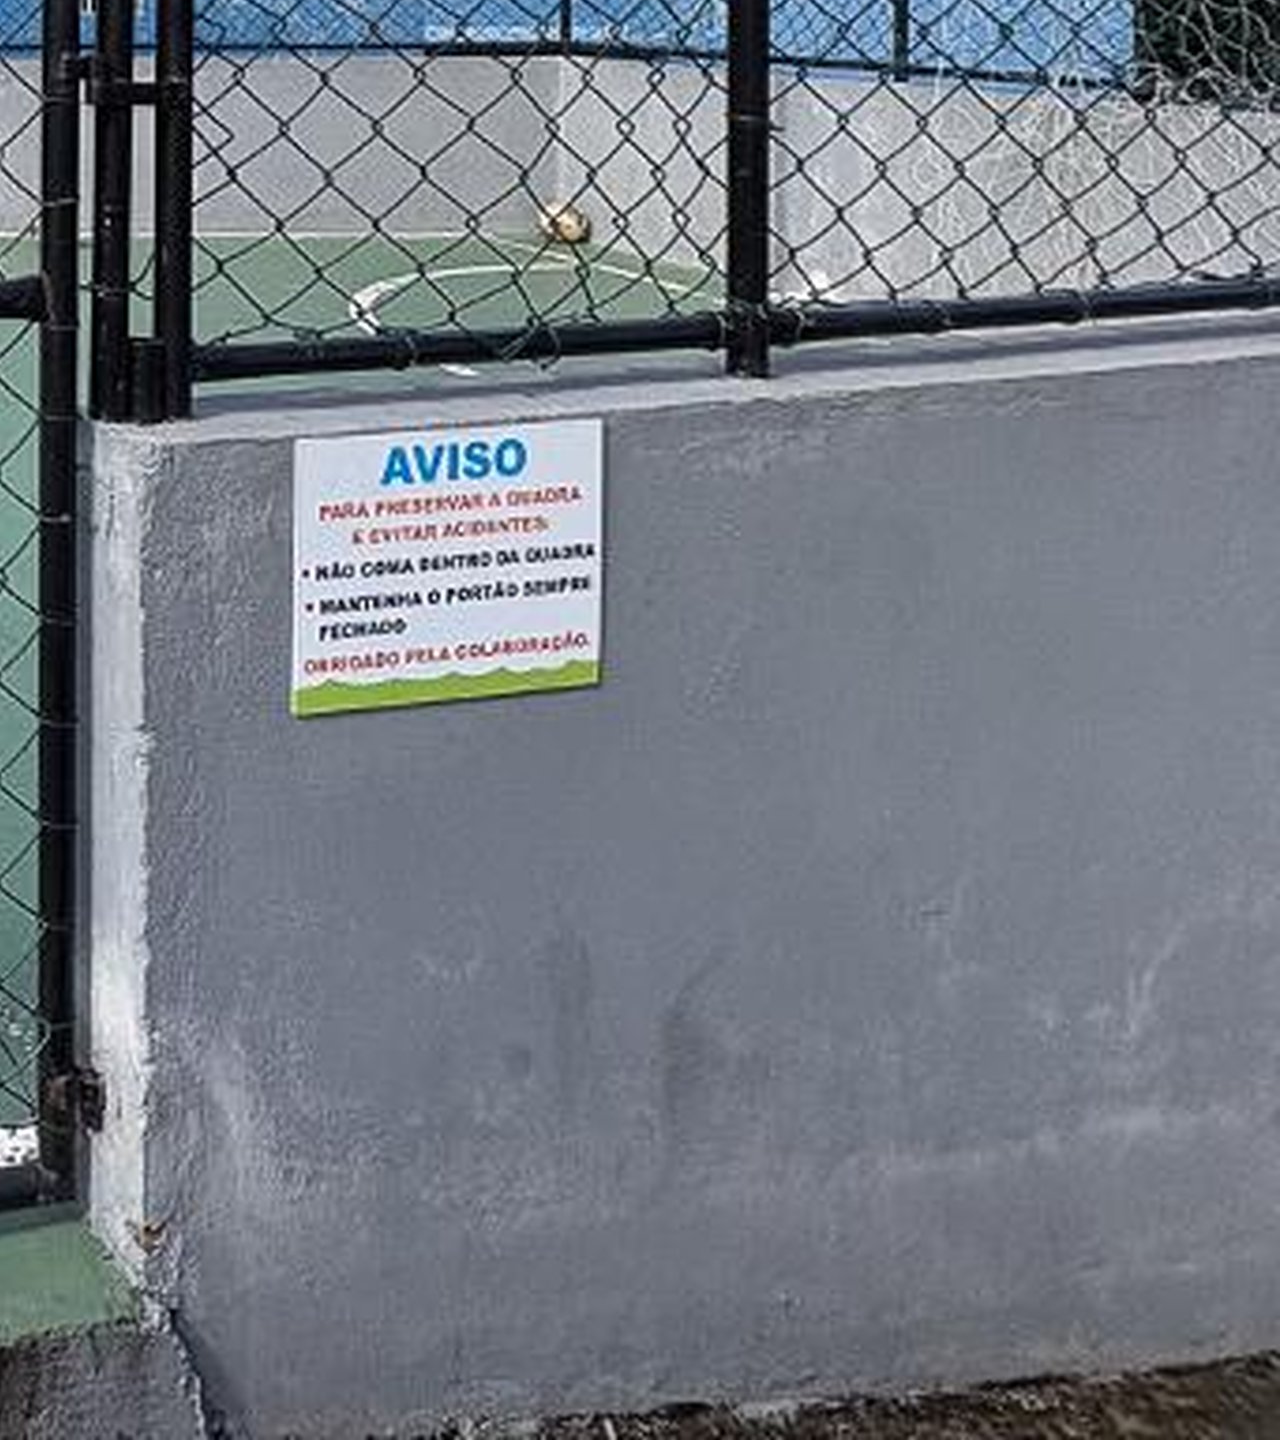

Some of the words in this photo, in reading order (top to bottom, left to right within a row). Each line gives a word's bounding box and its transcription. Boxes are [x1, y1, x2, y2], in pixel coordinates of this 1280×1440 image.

[379, 437, 527, 486] AVISO
[319, 500, 370, 522] PARA
[374, 492, 484, 517] PRESERVAR
[487, 491, 502, 507] A
[506, 485, 582, 506] QUADRA
[368, 523, 438, 545] EVITAR
[314, 561, 356, 581] NÃO
[360, 558, 415, 578] COMA
[419, 550, 492, 572] DENTRO
[496, 548, 520, 566] DA
[524, 543, 596, 564] QUADRA
[318, 590, 423, 615] MANTENHA
[427, 587, 441, 605] O
[446, 579, 520, 605] PORTÃO
[522, 574, 590, 597] SEMPRE
[318, 617, 408, 642] FECHADO
[303, 650, 401, 674] OBRIGADO
[404, 646, 452, 664] PELA
